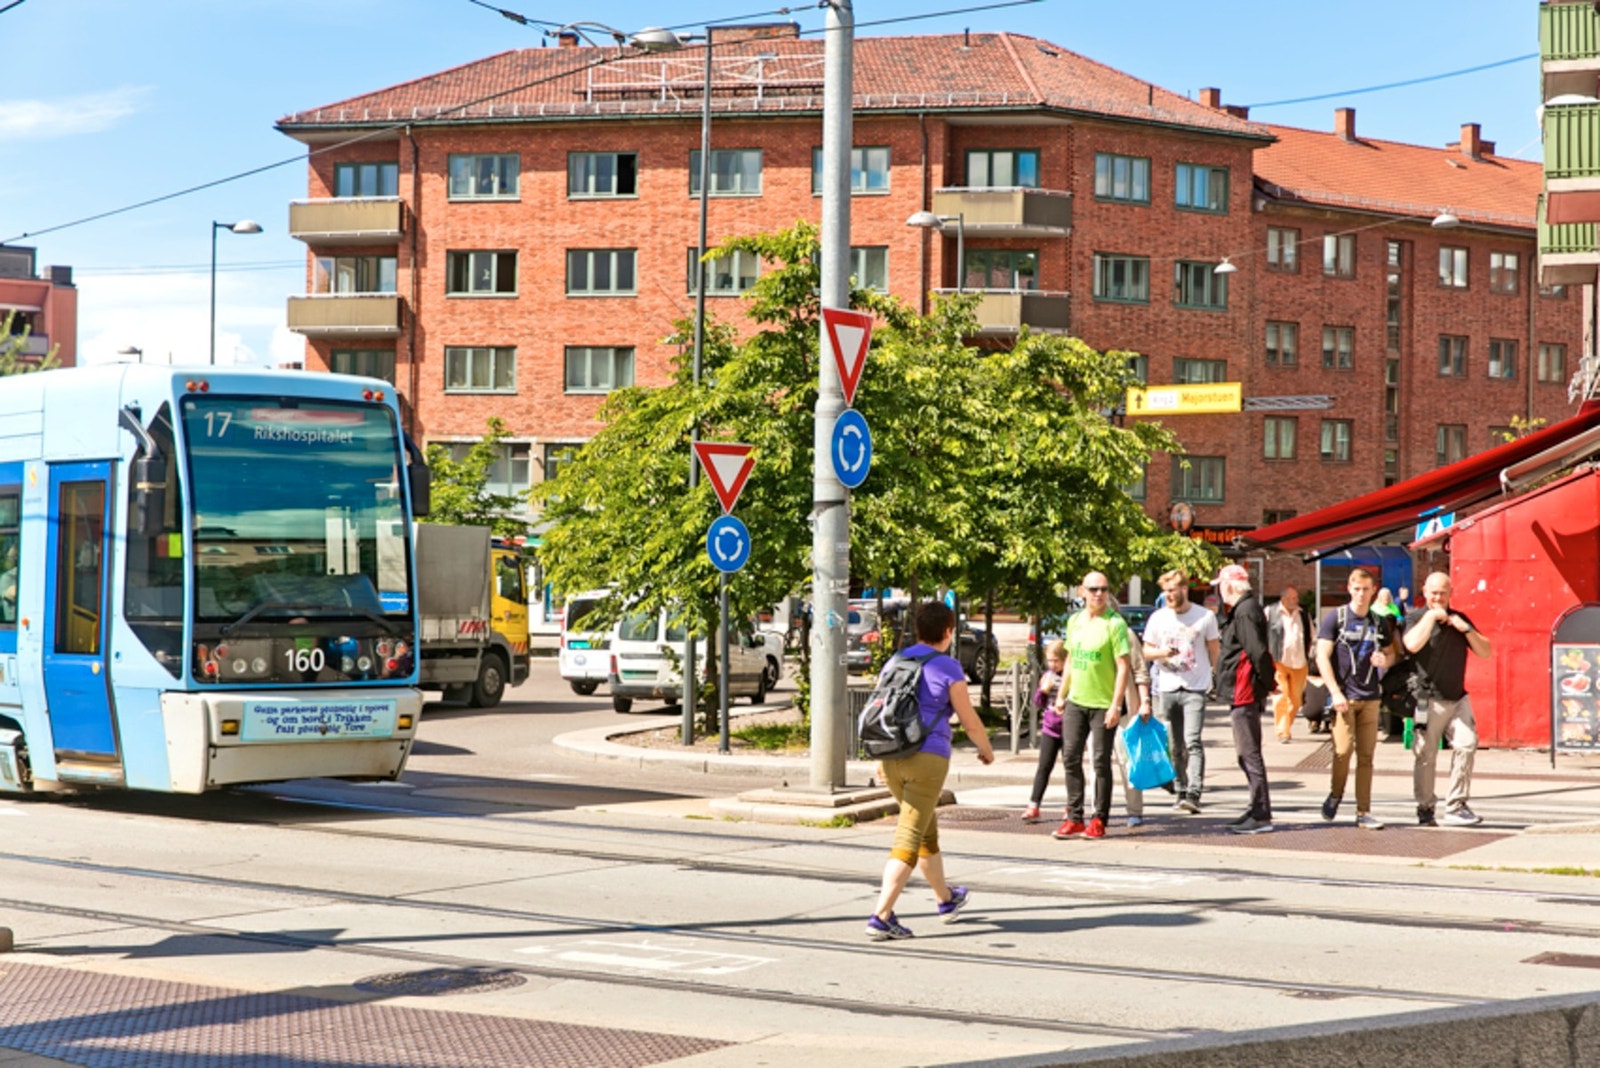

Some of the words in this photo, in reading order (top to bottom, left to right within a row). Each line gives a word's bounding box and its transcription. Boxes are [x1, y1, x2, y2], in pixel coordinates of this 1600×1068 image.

[1182, 393, 1234, 405] Majorstuen
[204, 411, 232, 438] 17
[254, 425, 353, 444] Rikshospitalet
[284, 647, 325, 672] 160
